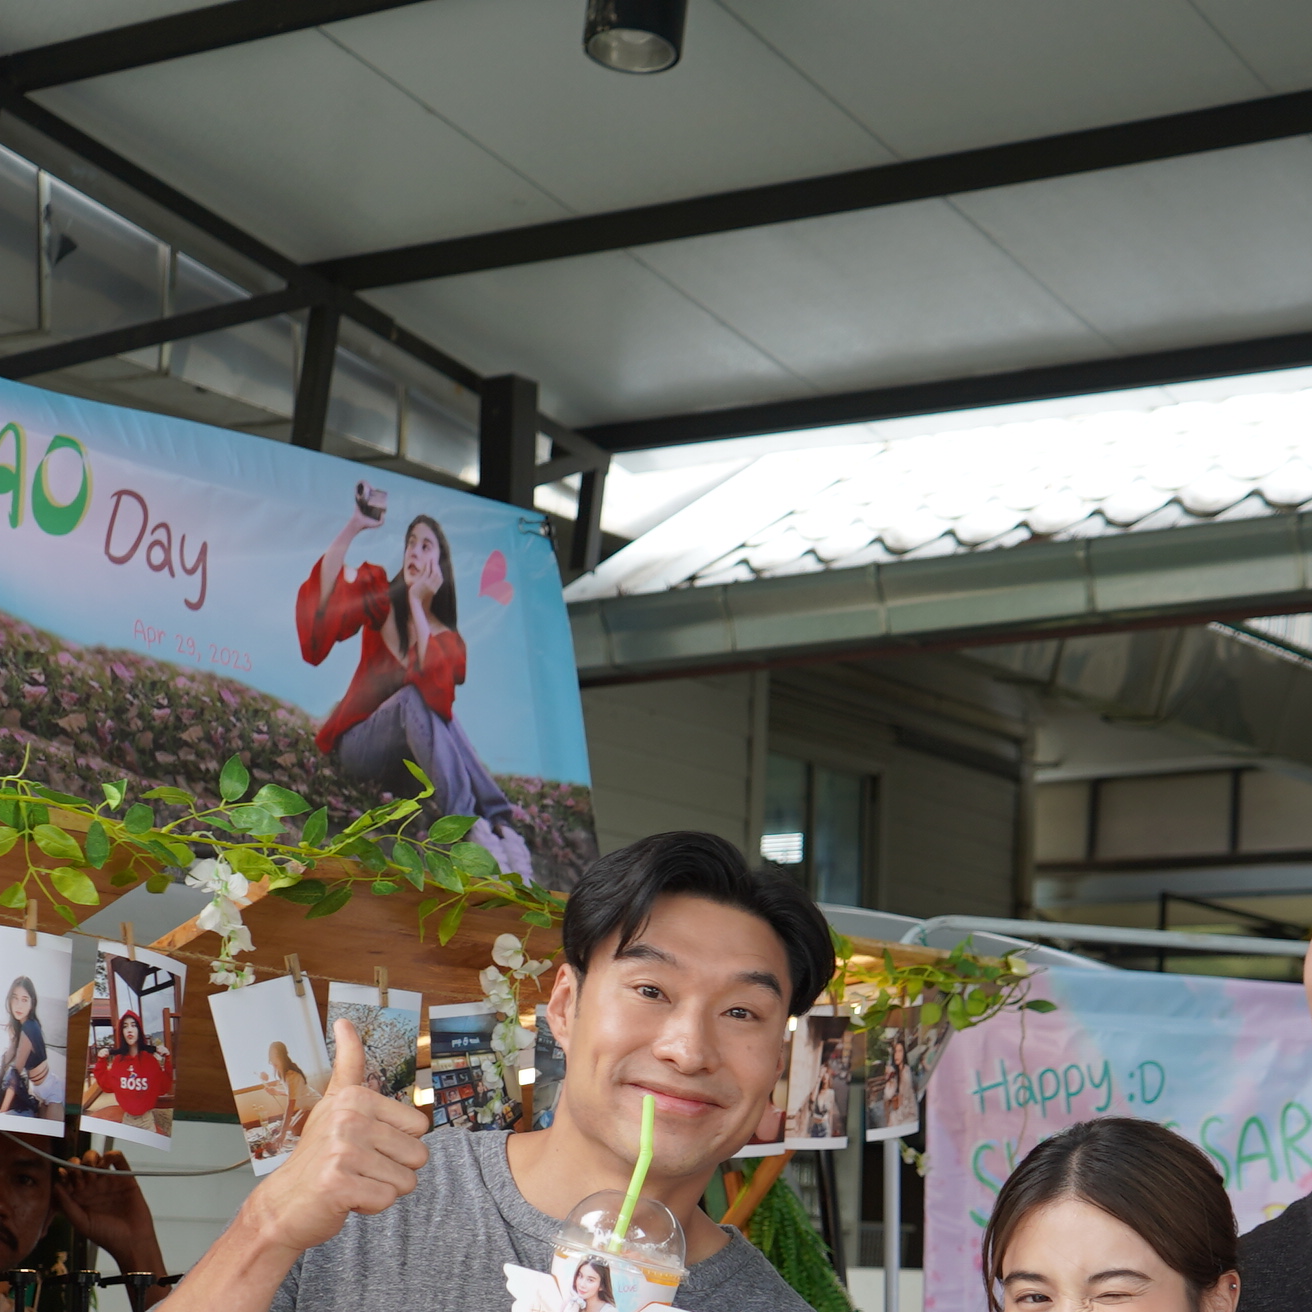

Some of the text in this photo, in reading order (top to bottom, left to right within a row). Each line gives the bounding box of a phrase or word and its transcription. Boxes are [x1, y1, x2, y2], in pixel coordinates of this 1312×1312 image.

[104, 488, 210, 611] Day
[134, 618, 252, 672] Apr 29, 2023
[120, 1076, 148, 1091] BOSS
[972, 1058, 1113, 1117] Happy
[618, 1284, 638, 1294] LOVE
